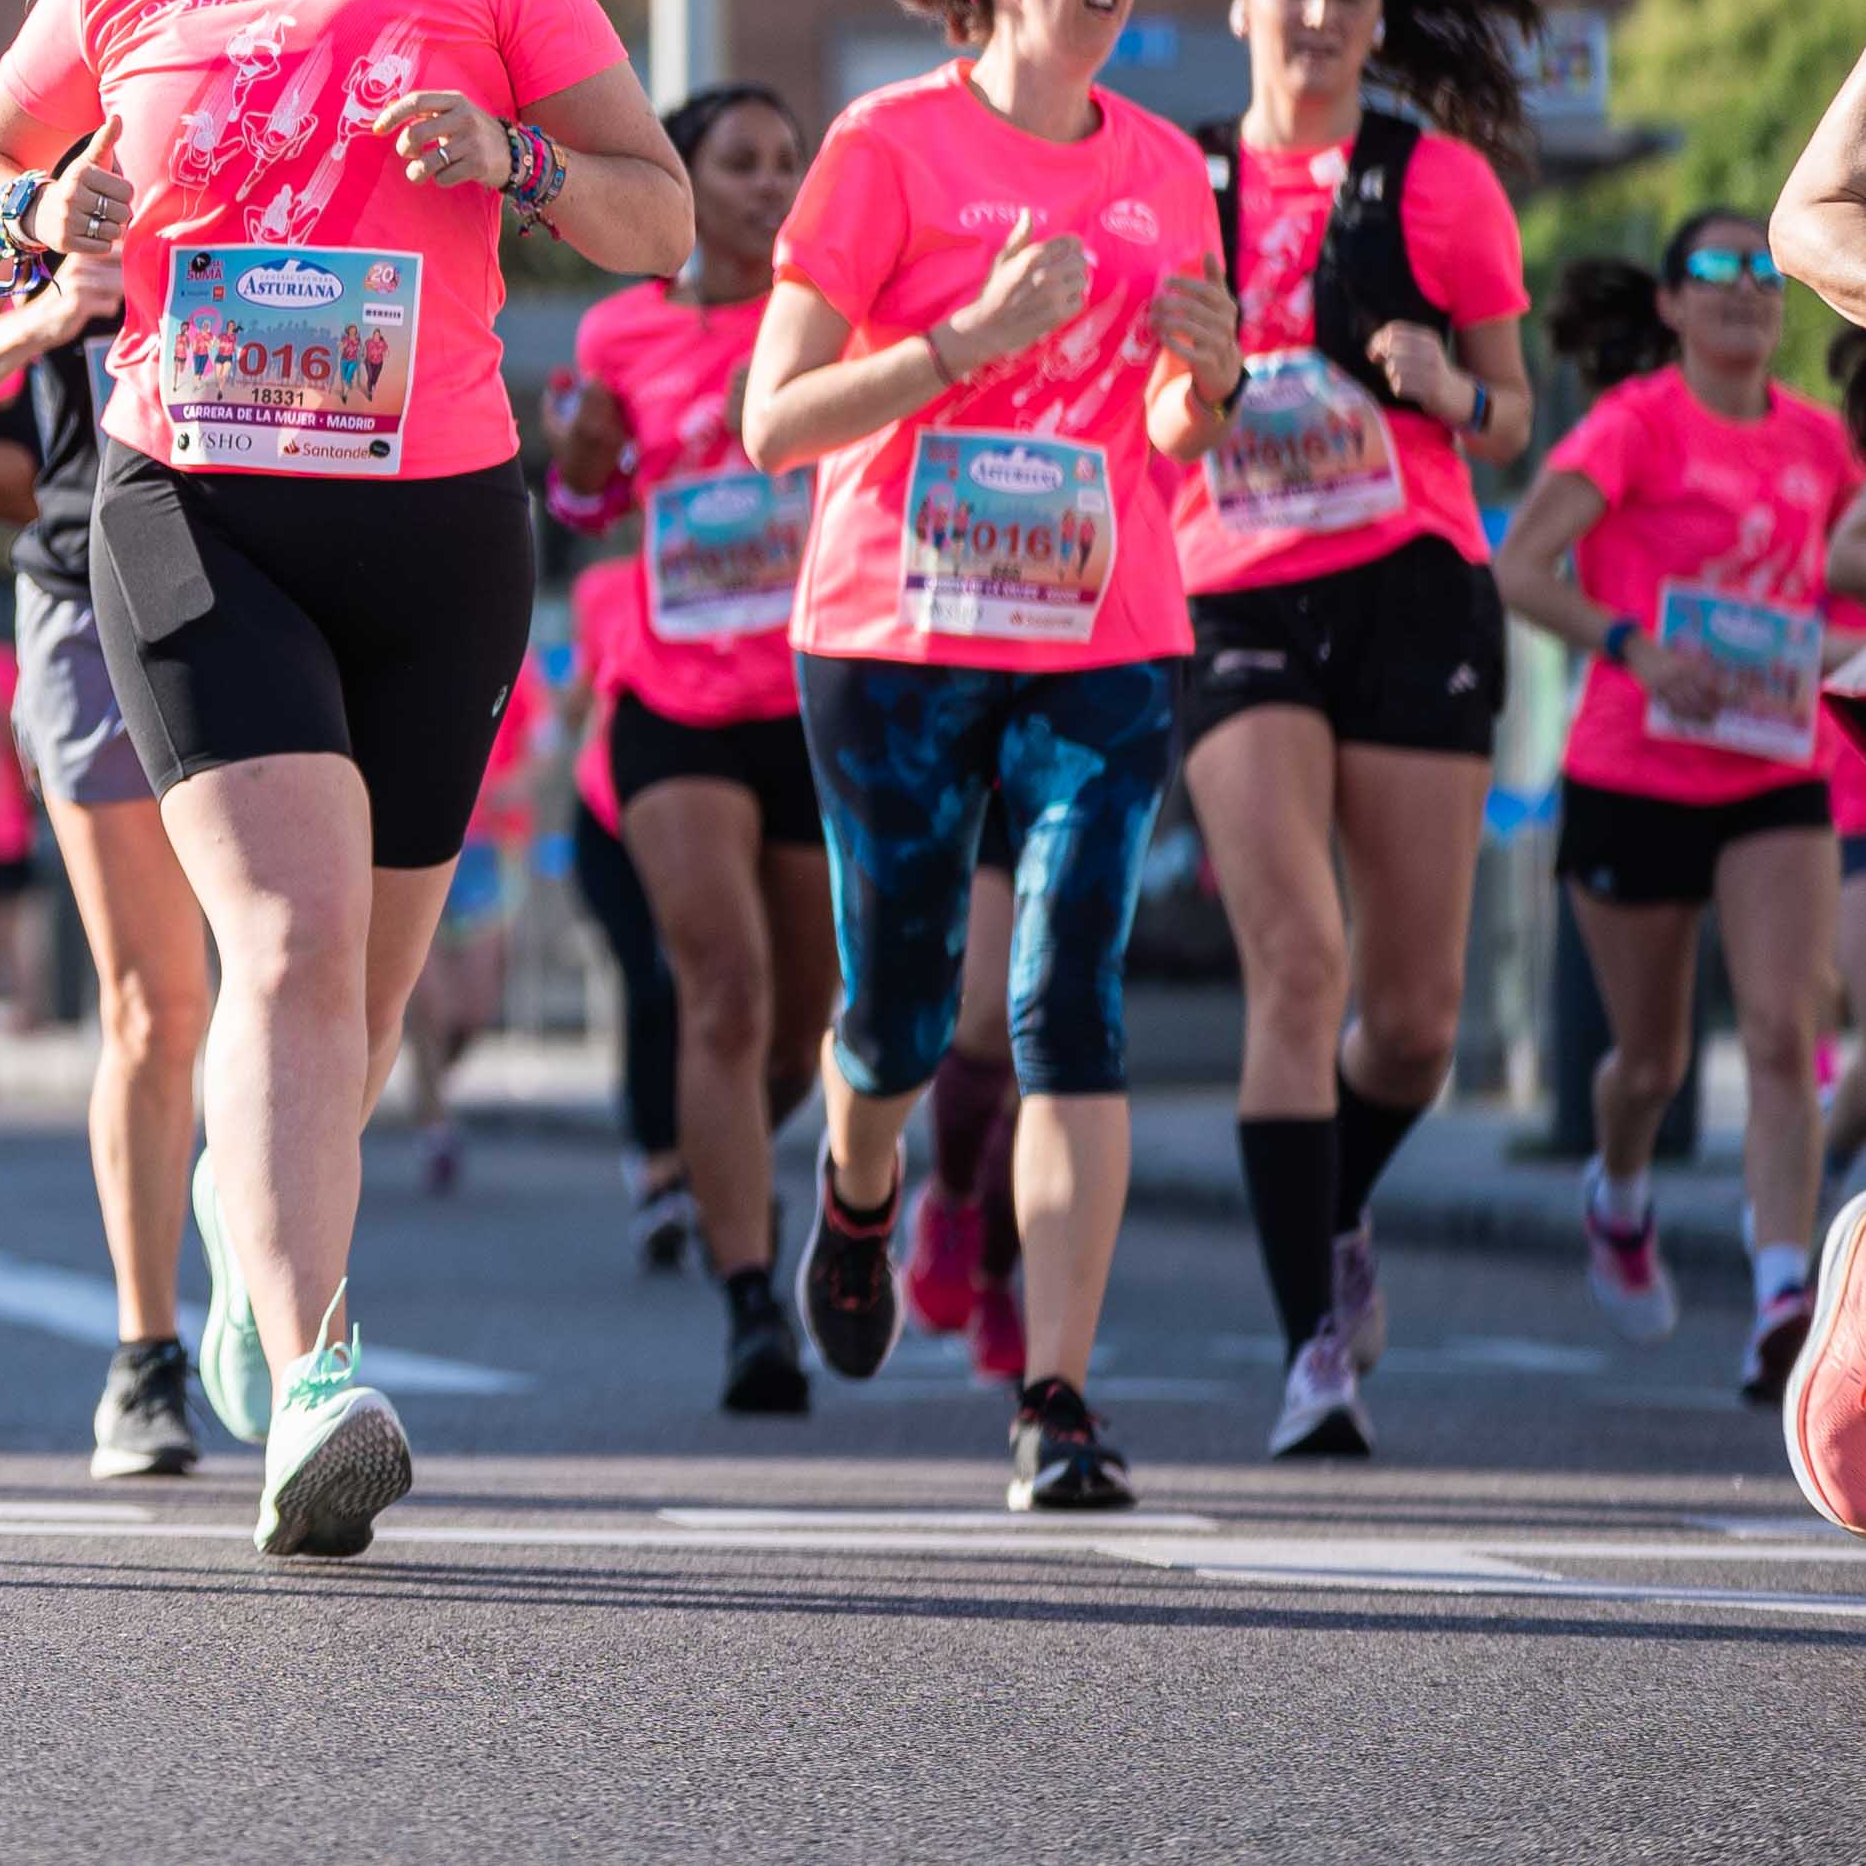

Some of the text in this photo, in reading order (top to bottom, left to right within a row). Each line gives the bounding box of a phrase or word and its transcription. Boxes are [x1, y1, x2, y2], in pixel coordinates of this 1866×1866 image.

[370, 265, 395, 282] 20
[244, 275, 336, 299] ASTURIANA
[238, 341, 332, 381] 016
[251, 388, 305, 407] 18331
[182, 405, 376, 431] CARRERA DE LA MUJER MADRID
[971, 519, 1053, 562] 016
